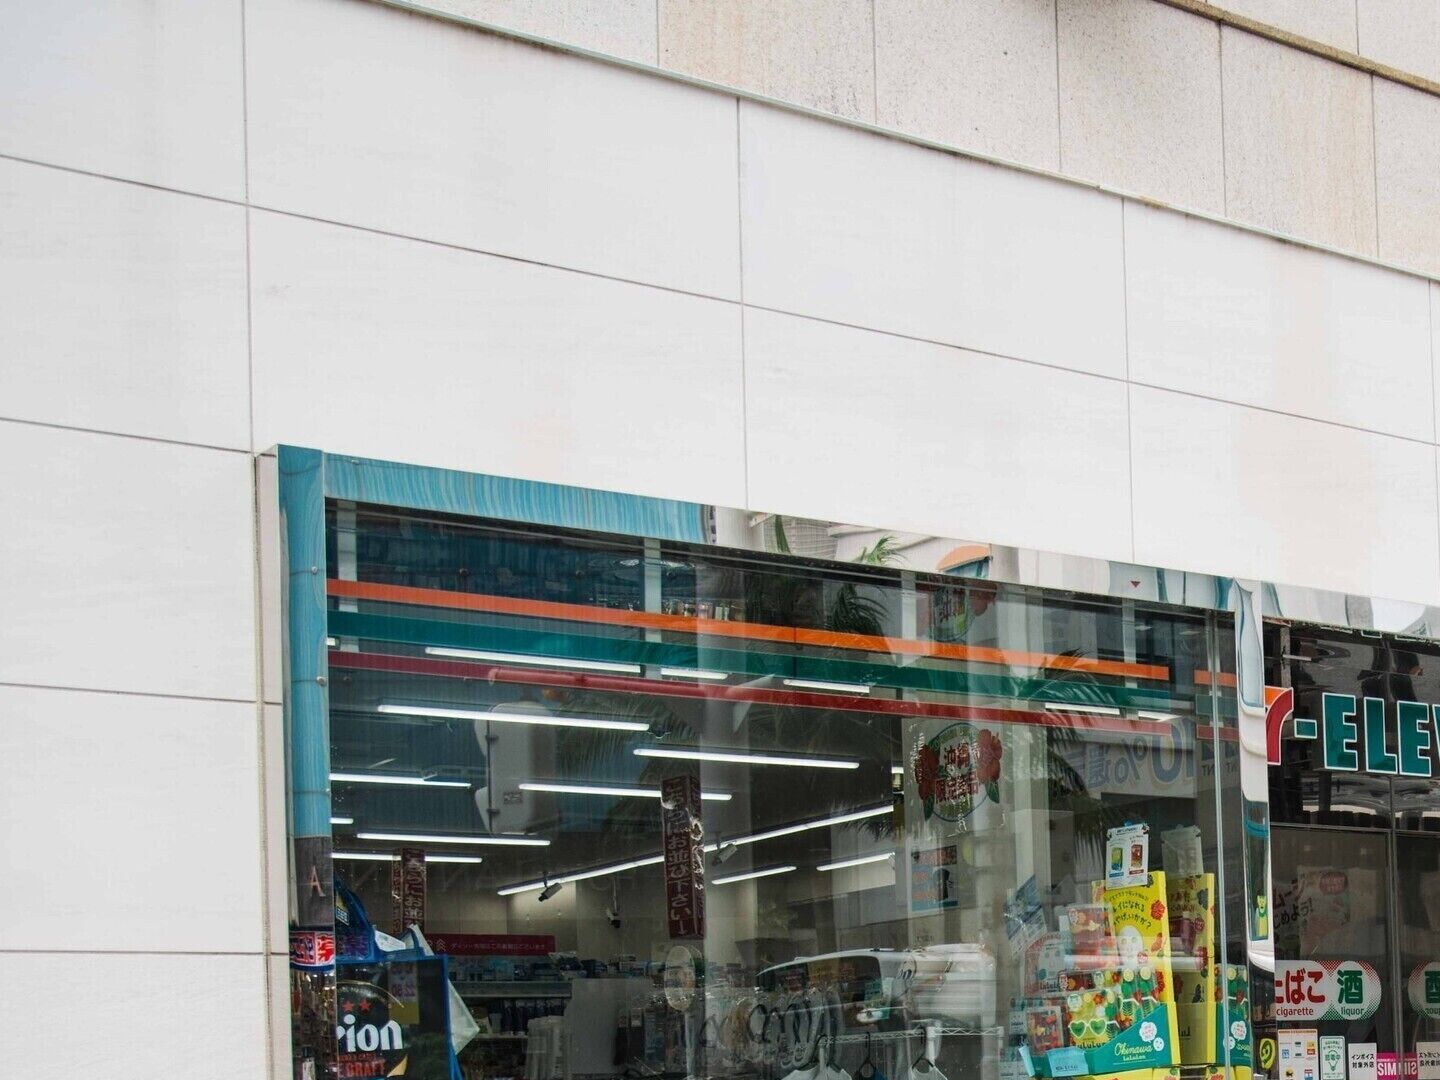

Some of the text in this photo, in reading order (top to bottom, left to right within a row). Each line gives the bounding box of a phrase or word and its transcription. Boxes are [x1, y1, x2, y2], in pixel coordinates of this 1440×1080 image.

[1337, 969, 1364, 1004] 酒
[1276, 1006, 1314, 1017] cigarette
[1341, 1006, 1365, 1017] liquor
[1377, 1061, 1397, 1076] SIM
